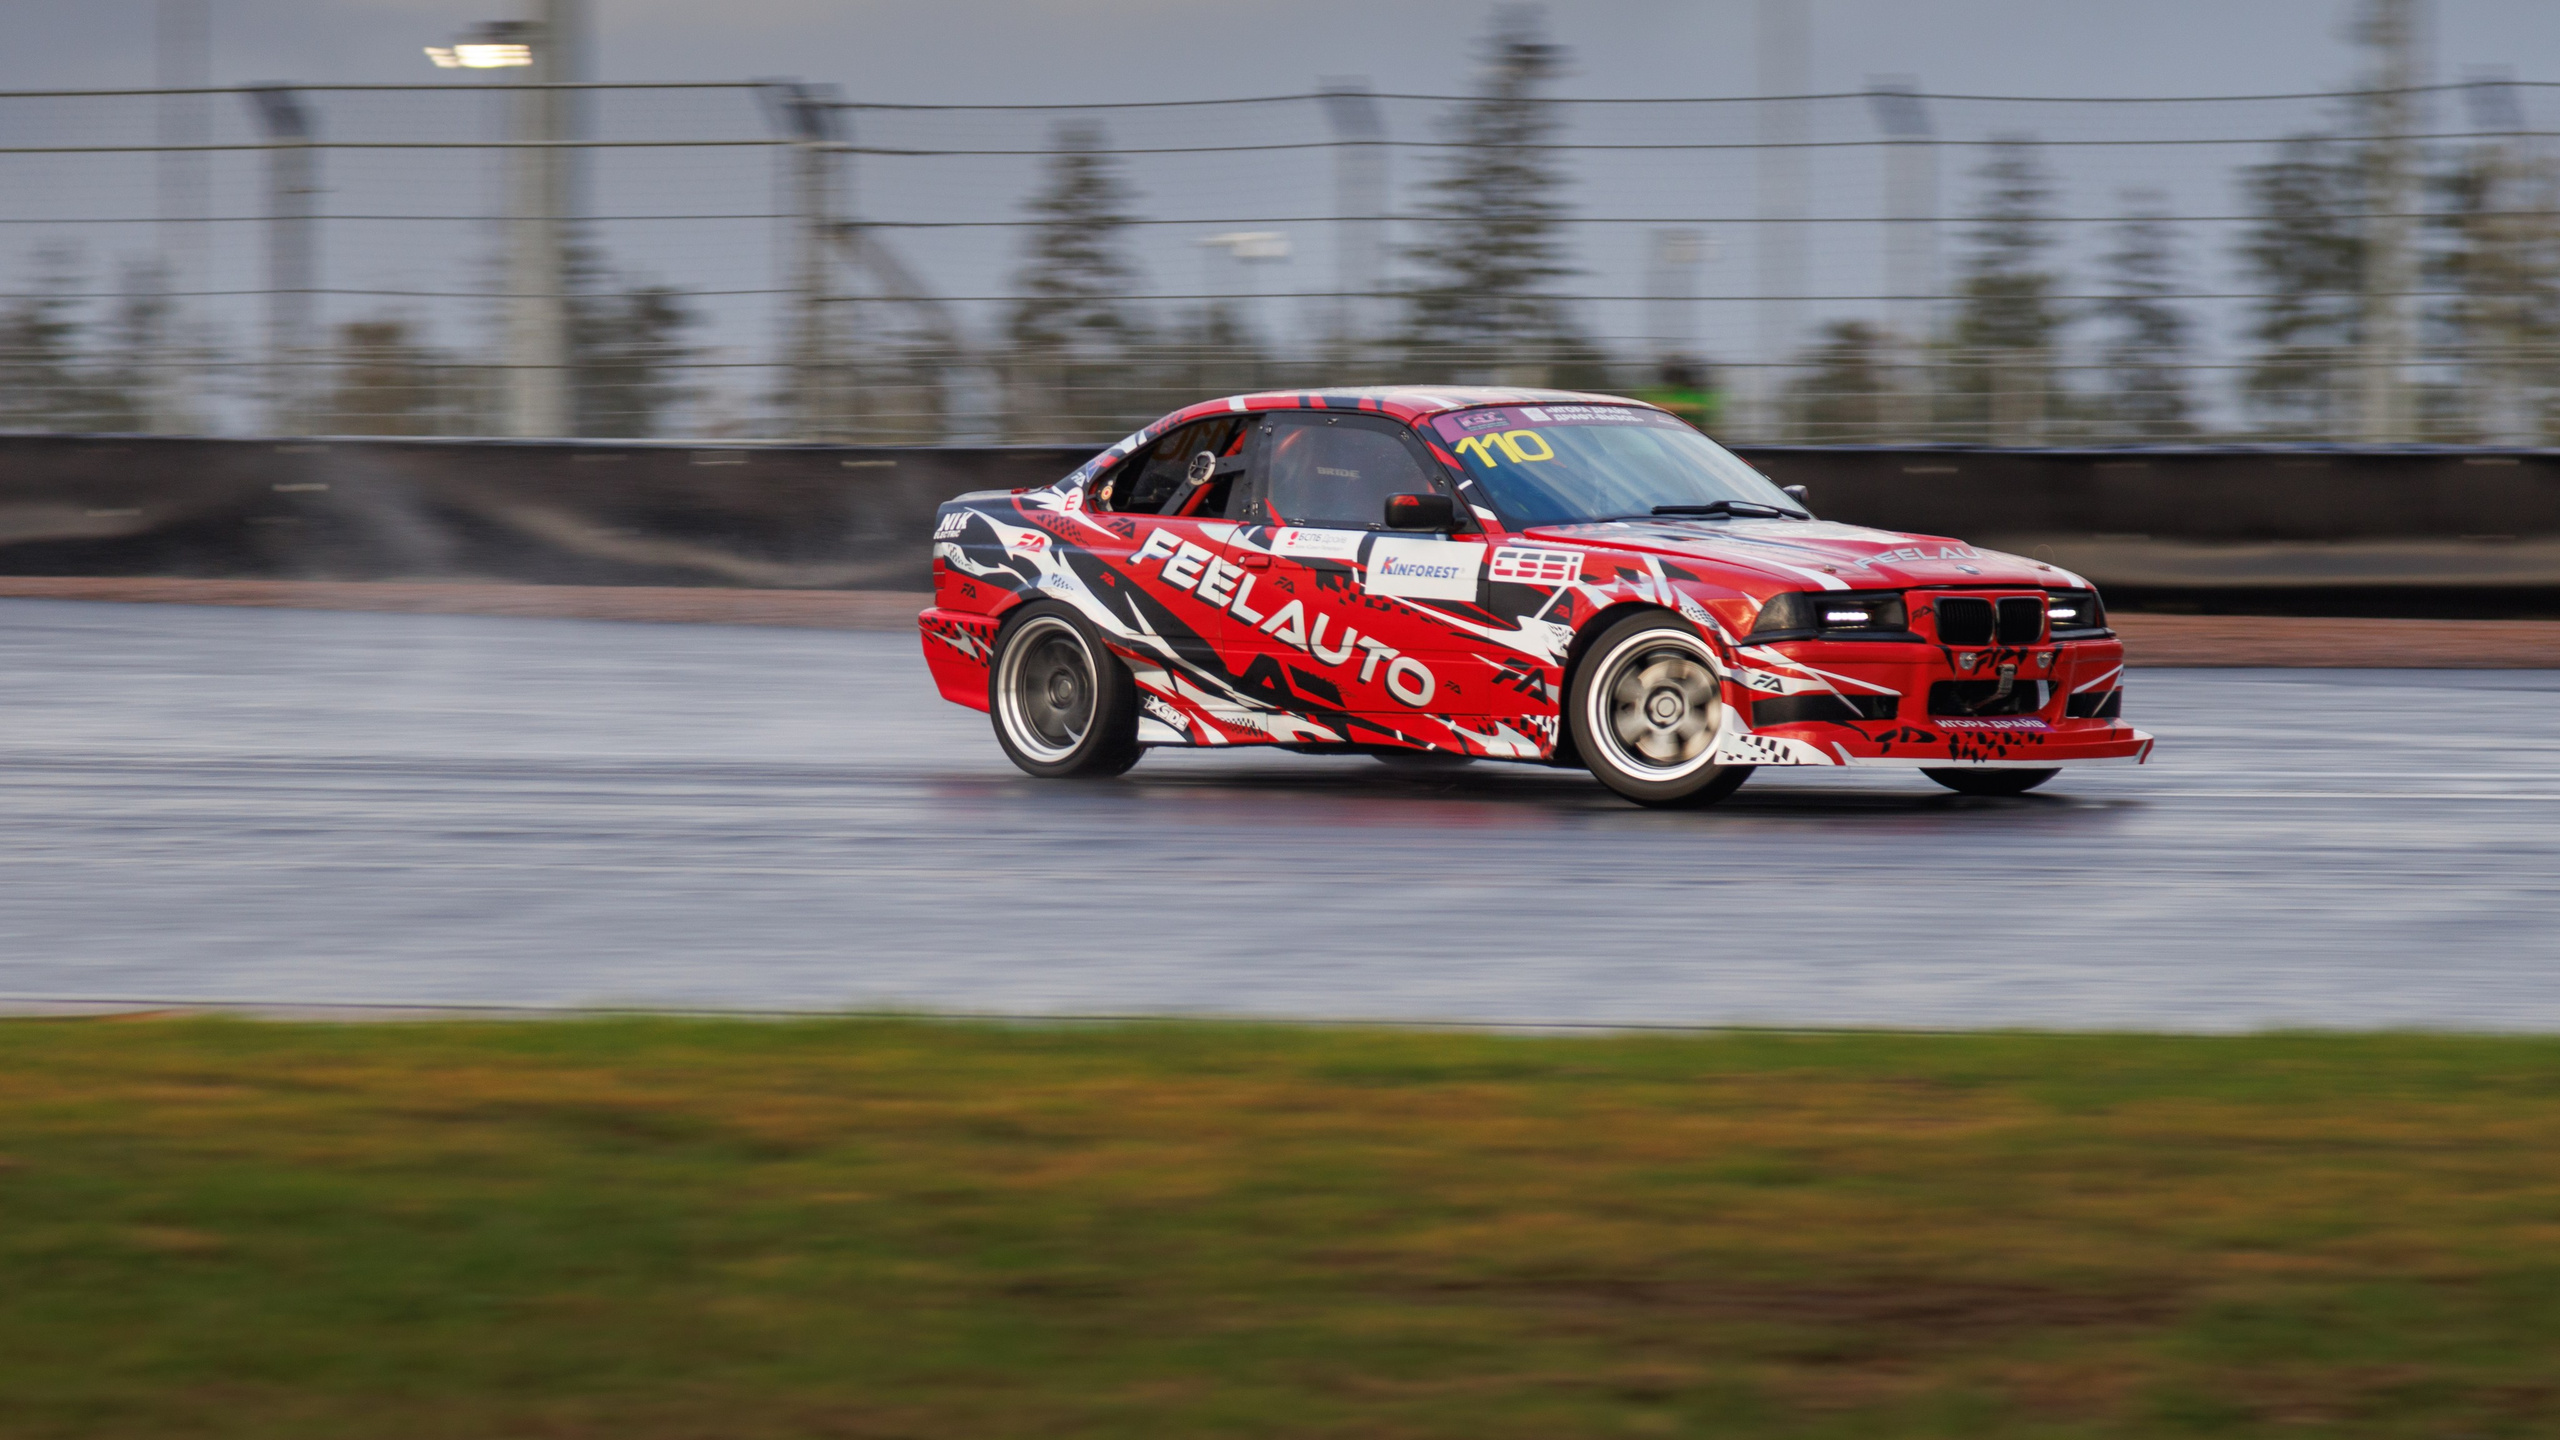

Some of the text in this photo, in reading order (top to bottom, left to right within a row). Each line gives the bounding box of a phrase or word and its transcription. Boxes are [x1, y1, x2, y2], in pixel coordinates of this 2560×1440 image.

[1454, 429, 1555, 468] 110
[1316, 466, 1360, 479] BRIDE
[1064, 494, 1078, 511] E
[937, 511, 976, 532] NIK
[933, 529, 961, 540] ELECTRIC
[1298, 533, 1322, 542] БСПБ
[1380, 556, 1460, 579] KINFOREST
[1130, 527, 1436, 708] FEELAUTO
[1752, 673, 1784, 693] FA
[1935, 718, 2047, 729] ИГОРА ДРАЙВ
